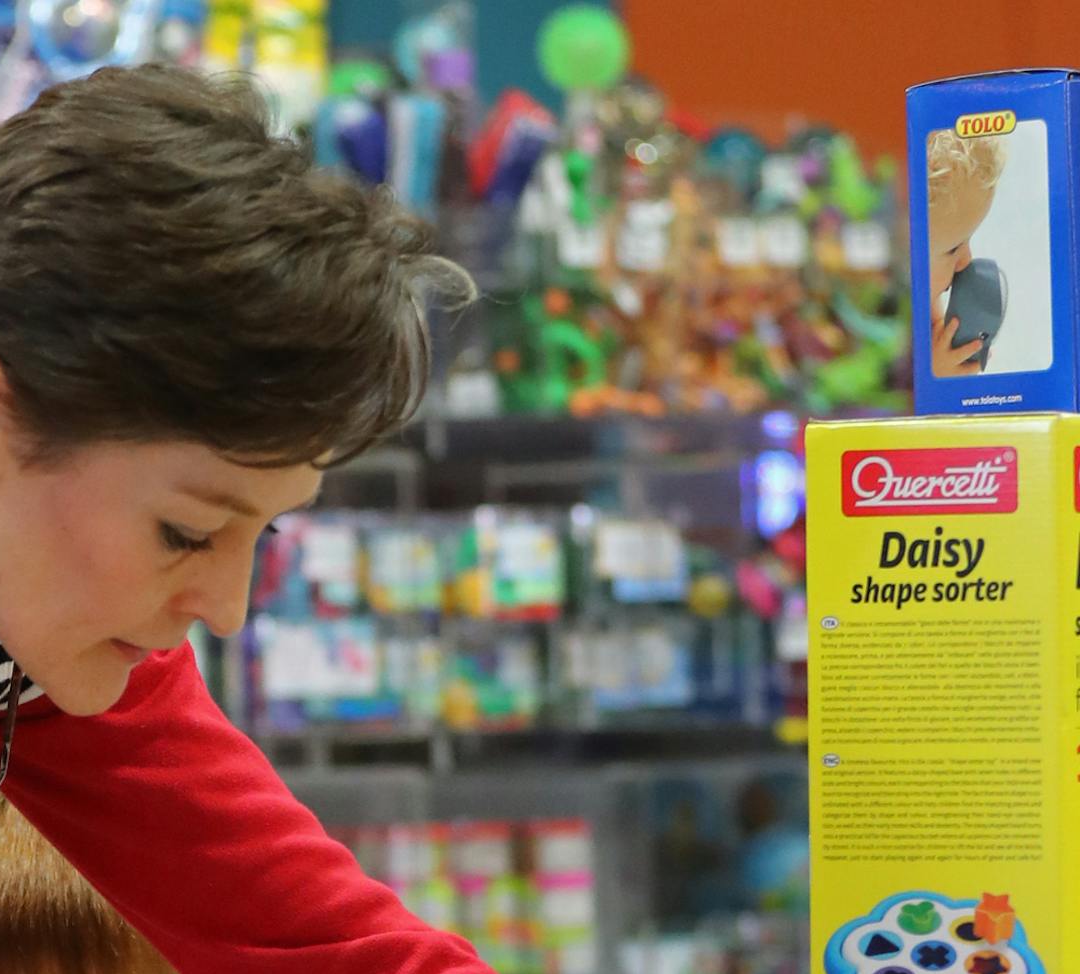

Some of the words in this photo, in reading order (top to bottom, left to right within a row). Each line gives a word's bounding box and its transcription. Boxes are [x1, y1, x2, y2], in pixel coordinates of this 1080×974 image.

[961, 115, 1004, 135] TOLO
[851, 455, 1007, 507] Quercetti
[878, 526, 985, 577] Daisy
[850, 576, 927, 609] shape
[932, 577, 1013, 602] sorter
